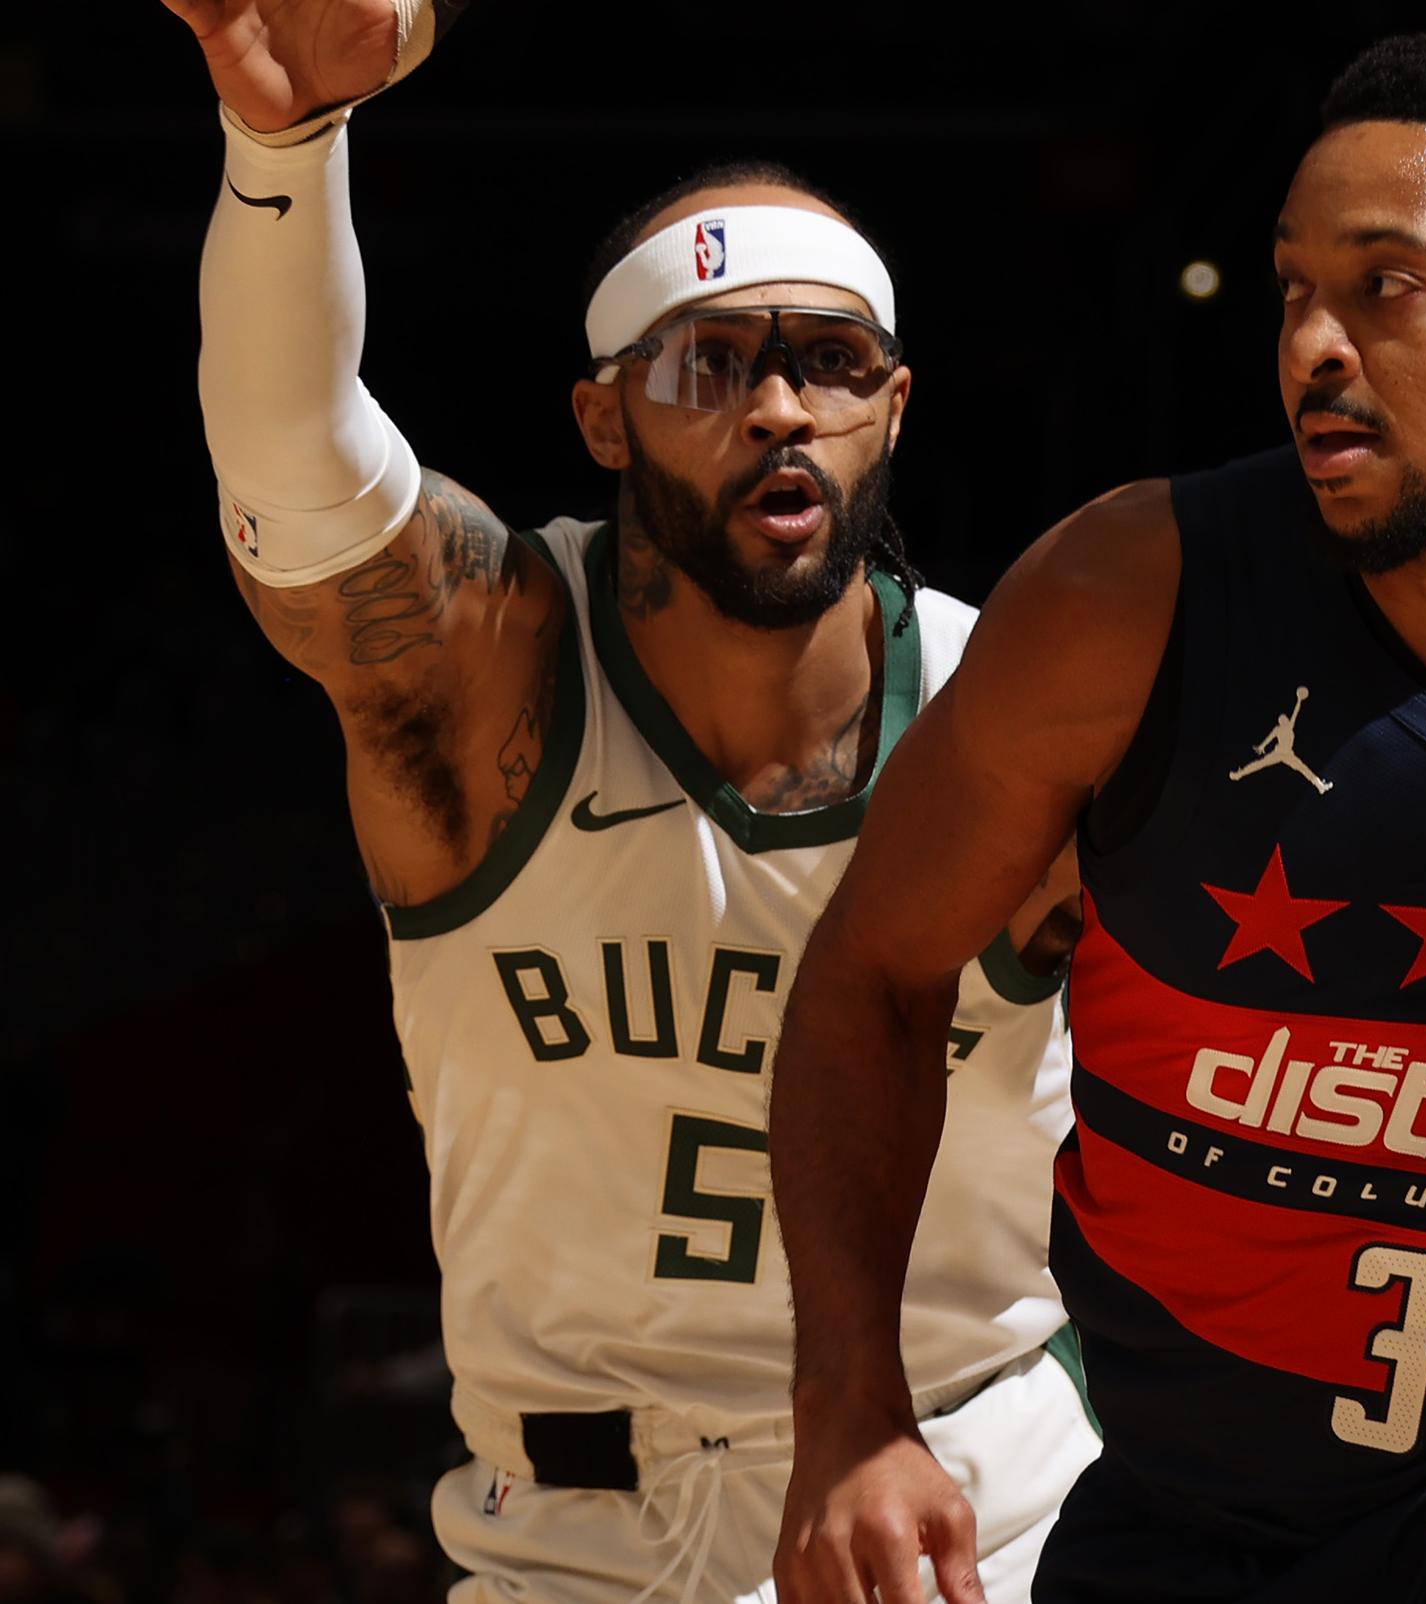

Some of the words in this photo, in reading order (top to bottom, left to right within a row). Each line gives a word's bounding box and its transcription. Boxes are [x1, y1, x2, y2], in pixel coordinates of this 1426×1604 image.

[490, 935, 988, 1077] BUC
[1329, 1040, 1410, 1071] THE
[1167, 1130, 1224, 1167] OF
[652, 1111, 770, 1286] 5
